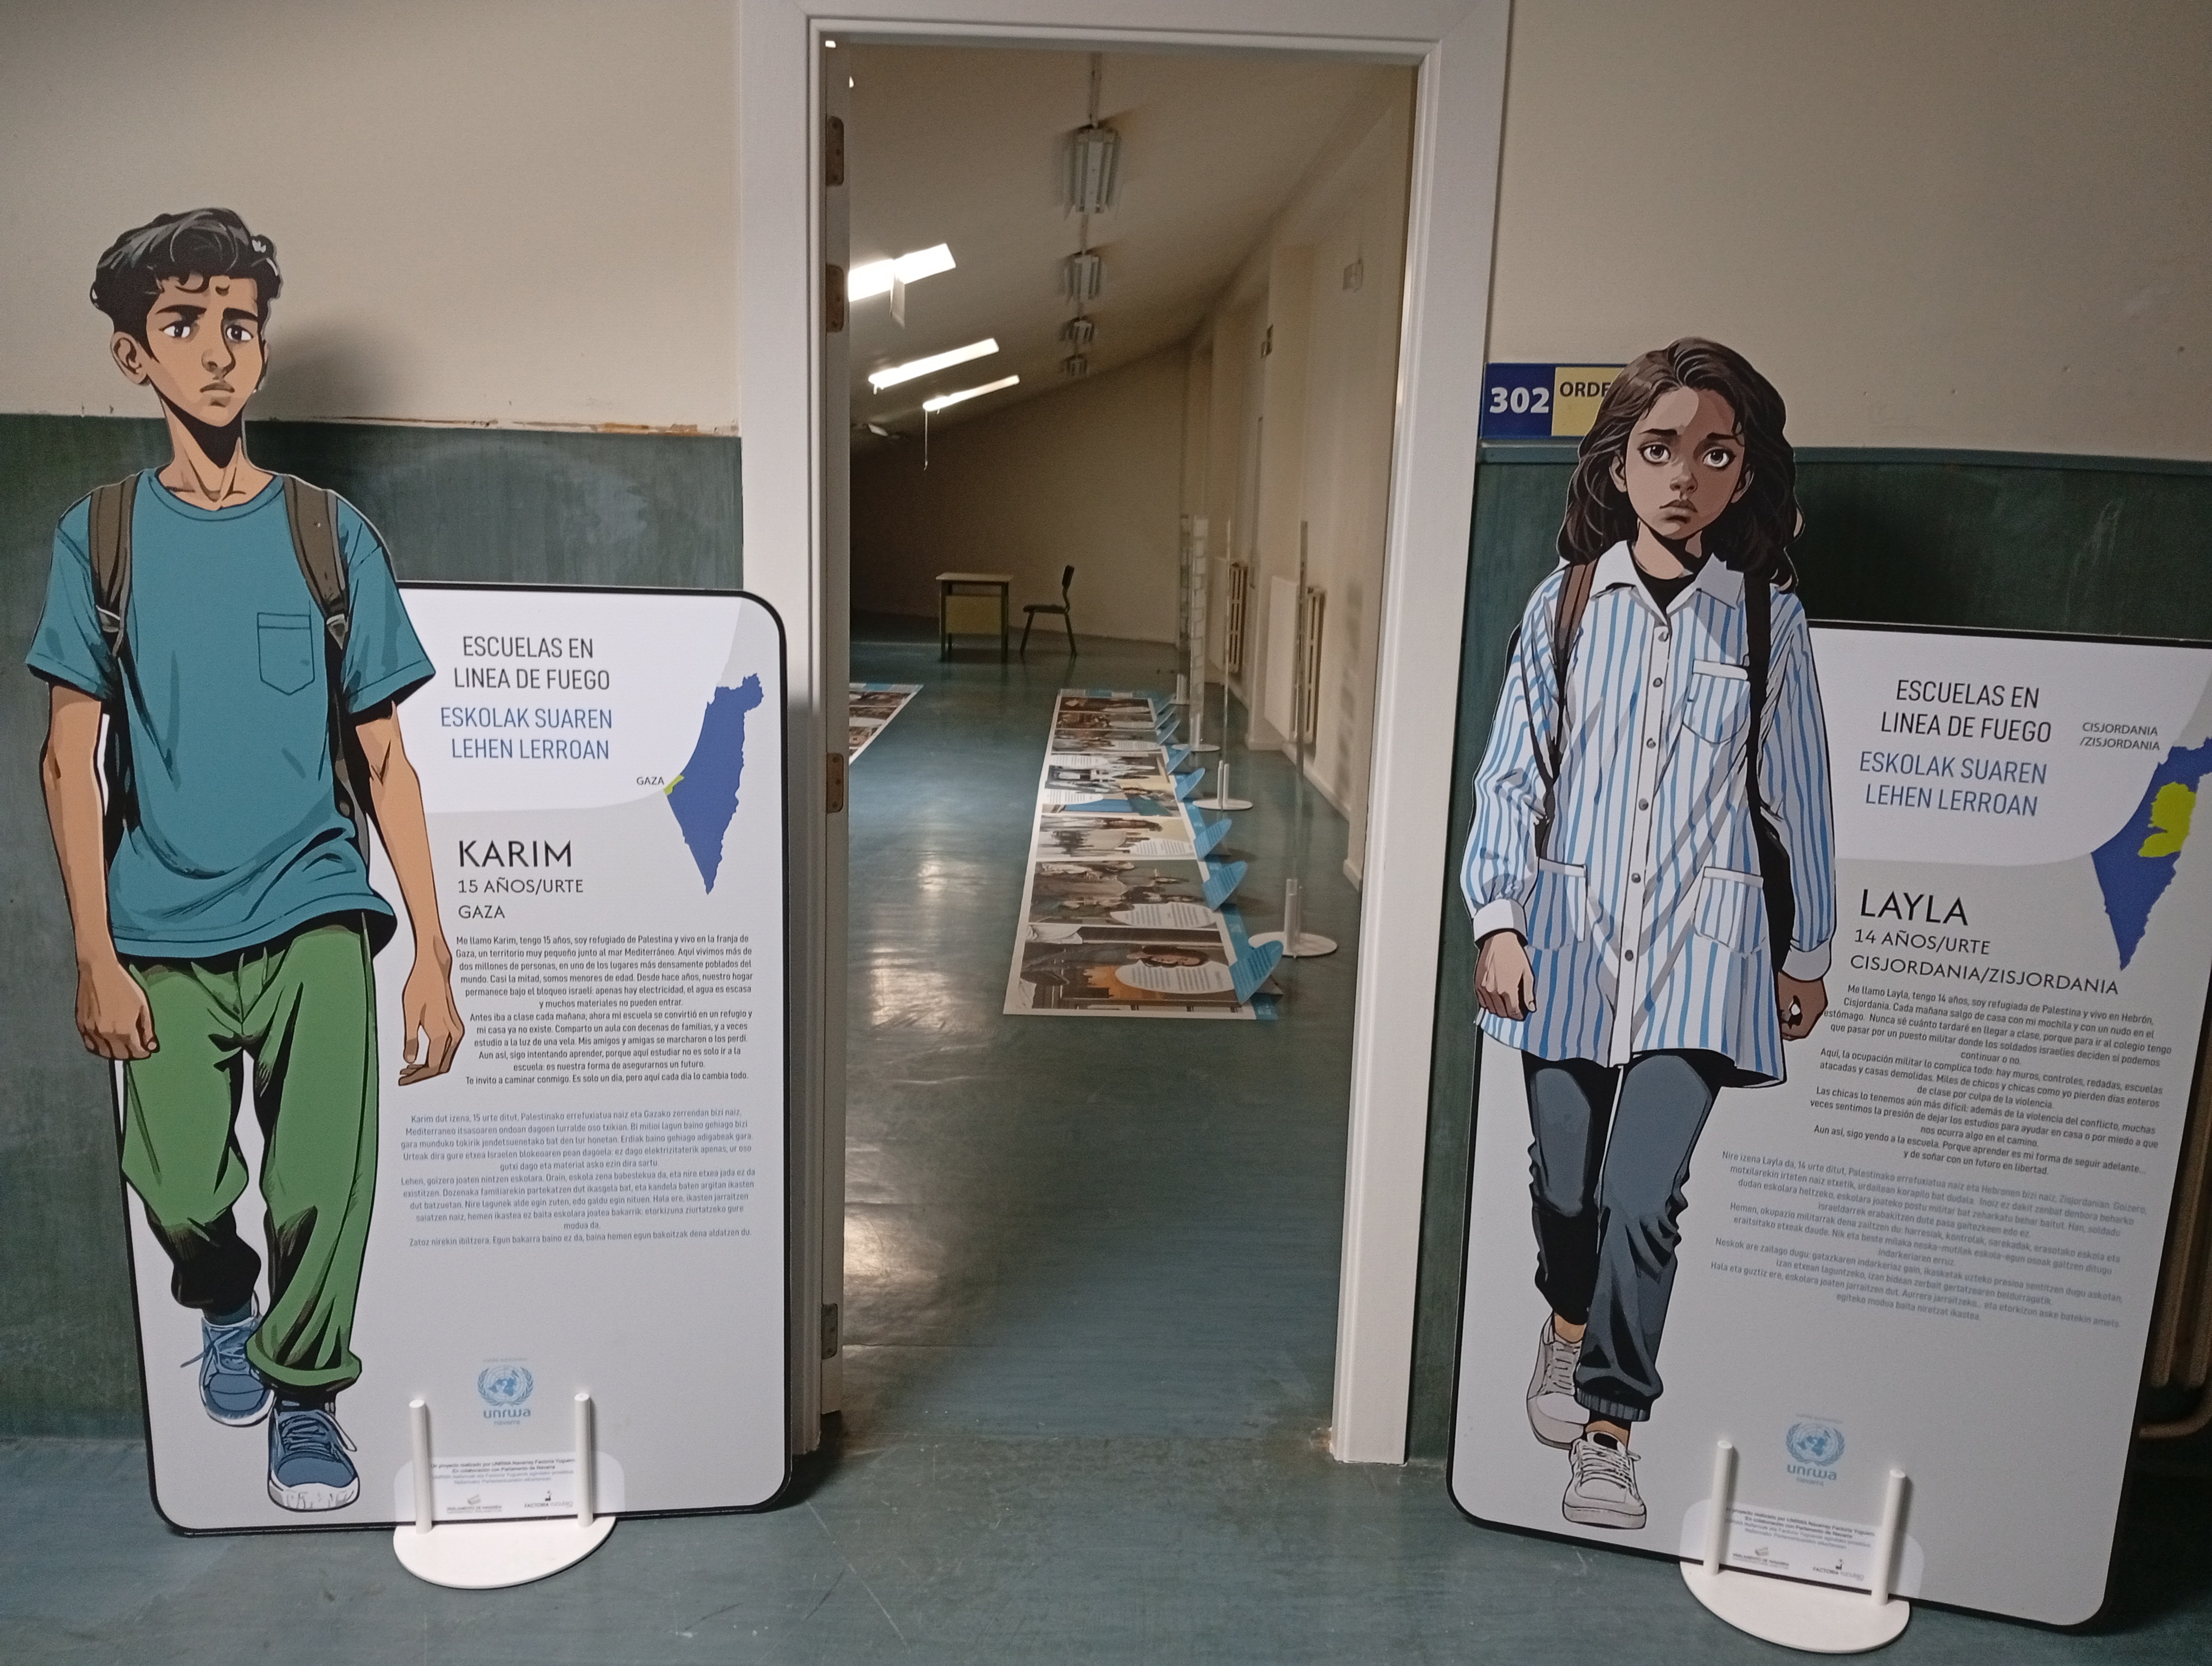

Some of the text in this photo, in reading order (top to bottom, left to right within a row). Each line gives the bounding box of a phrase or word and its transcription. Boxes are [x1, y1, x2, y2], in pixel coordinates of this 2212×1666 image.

[1489, 387, 1549, 414] 302
[462, 636, 593, 659] ESCUELAS EN
[454, 667, 610, 690] LINEA DE FUEGO
[1896, 679, 2040, 709] ESCUELAS EN
[441, 707, 612, 729] ESKOLAK SUAREN
[1881, 711, 2052, 743] LINEA DE FUEGO
[2082, 722, 2158, 736] CISJORDANIA
[452, 738, 609, 760] LEHEN LERROAN
[2079, 736, 2160, 751] /ZISJORDANIA
[1860, 751, 2047, 785] ESKOLAK SUAREN
[636, 776, 665, 785] GAZA
[1866, 783, 2038, 817] LEHEN LERROAN
[459, 840, 571, 867] KARIM
[458, 876, 583, 895] 15 AÑOS/URTE
[458, 905, 505, 919] GAZA
[1860, 888, 1968, 926] LAYLA
[456, 936, 468, 945] Me
[470, 936, 492, 945] llamo
[493, 936, 518, 946] Karim,
[519, 937, 542, 946] tengo
[543, 935, 551, 944] 15
[574, 937, 588, 945] soy
[589, 935, 626, 945] refugiado
[627, 935, 636, 944] de
[638, 934, 673, 944] Palestina
[674, 936, 679, 945] y
[680, 935, 696, 944] vivo
[707, 934, 715, 943] la
[716, 934, 738, 945] franja
[740, 934, 749, 943] de
[1854, 928, 1991, 955] 14 AÑOS/URTE
[455, 949, 477, 959] Gaza,
[490, 949, 525, 958] territorio
[526, 950, 543, 959] muy
[544, 949, 577, 959] pequeño
[577, 949, 597, 958] junto
[599, 948, 606, 957] al
[677, 947, 695, 957] Aquí
[696, 947, 724, 956] vivimos
[725, 947, 742, 956] más
[743, 947, 752, 956] de
[459, 962, 473, 971] dos
[474, 962, 508, 971] millones
[509, 962, 519, 971] de
[520, 963, 558, 971] personas,
[586, 960, 595, 970] de
[596, 960, 609, 970] los
[610, 960, 639, 971] lugares
[640, 960, 656, 969] más
[658, 960, 704, 969] densamente
[705, 959, 739, 970] poblados
[740, 959, 751, 968] del
[1850, 954, 2118, 995] CISJORDANIA/ZISJORDANIA
[1847, 984, 1860, 994] Me
[1861, 985, 1886, 997] llamo
[1912, 991, 1936, 1003] tengo
[1938, 994, 1946, 1003] 14
[1971, 999, 1987, 1009] soy
[1987, 999, 2028, 1012] refugiada
[2029, 1003, 2041, 1013] de
[2041, 1004, 2081, 1017] Palestina
[2082, 1010, 2089, 1020] y
[2089, 1010, 2107, 1020] vivo
[2108, 1013, 2120, 1021] en
[1892, 1002, 1914, 1013] Cada
[1915, 1006, 1949, 1017] mañana
[1949, 1009, 1973, 1021] salgo
[1973, 1011, 1985, 1021] de
[1986, 1014, 2007, 1023] casa
[2008, 1016, 2024, 1024] con
[2025, 1017, 2036, 1026] mi
[2037, 1019, 2072, 1030] mochila
[2073, 1023, 2079, 1032] y
[2080, 1024, 2097, 1033] con
[2110, 1027, 2132, 1036] nudo
[2133, 1029, 2144, 1037] en
[2145, 1030, 2155, 1039] el
[1960, 1051, 2001, 1062] continuar
[411, 1115, 434, 1123] Karim
[435, 1114, 448, 1123] dut
[473, 1113, 481, 1122] 15
[482, 1114, 498, 1122] urte
[520, 1112, 565, 1121] Palestinako
[566, 1111, 612, 1120] errefuxiatua
[613, 1111, 629, 1119] naiz
[630, 1110, 642, 1119] eta
[644, 1110, 671, 1118] Gazako
[672, 1108, 709, 1118] zerrendan
[710, 1108, 724, 1117] bizi
[483, 1408, 531, 1419] unrwa
[1786, 1464, 1837, 1481] unrwa
